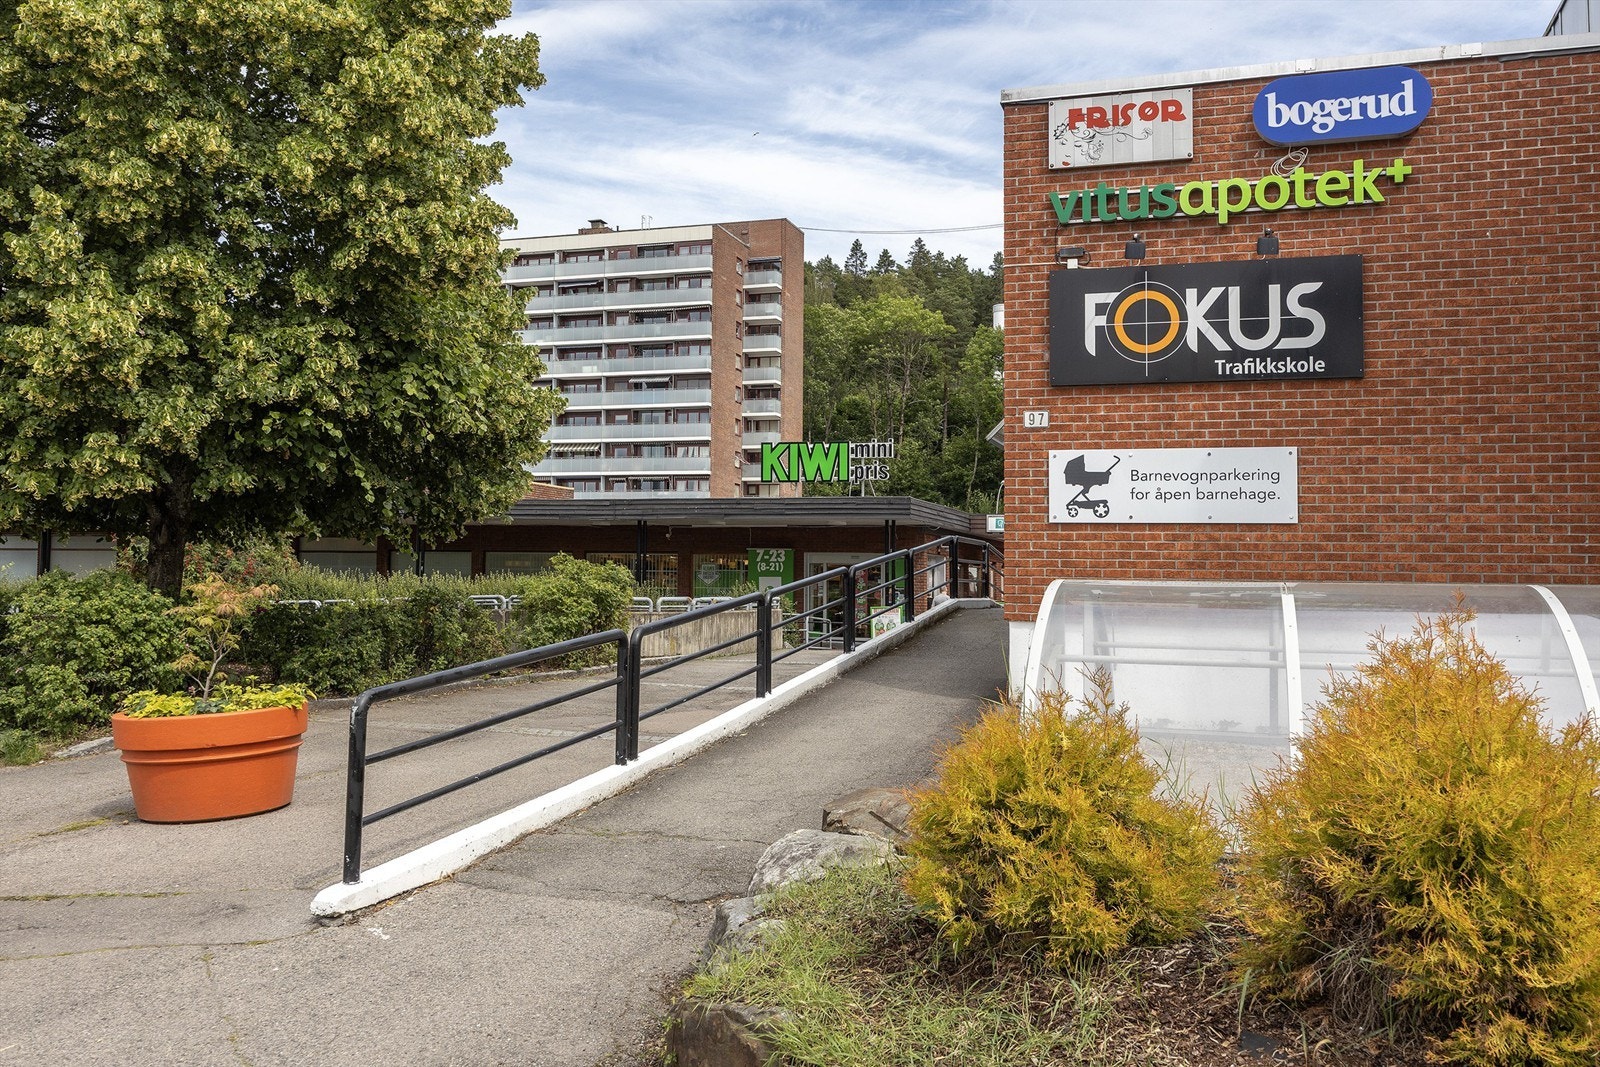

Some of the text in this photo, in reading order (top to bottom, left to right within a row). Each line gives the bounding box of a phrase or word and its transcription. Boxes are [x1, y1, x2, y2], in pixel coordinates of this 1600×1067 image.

[1068, 99, 1187, 131] FRISØR
[1265, 79, 1418, 135] bogerud
[1084, 281, 1326, 357] FOKUS
[1214, 355, 1326, 376] Trafikkskole
[1028, 412, 1045, 426] 97
[853, 438, 894, 459] mini
[761, 441, 850, 483] KIWI
[853, 459, 891, 485] pris
[1130, 468, 1280, 484] Barnevognparkering
[1130, 487, 1281, 503] for åpen barnehage.
[756, 549, 786, 562] 7-23
[757, 562, 784, 573] (8-21)
